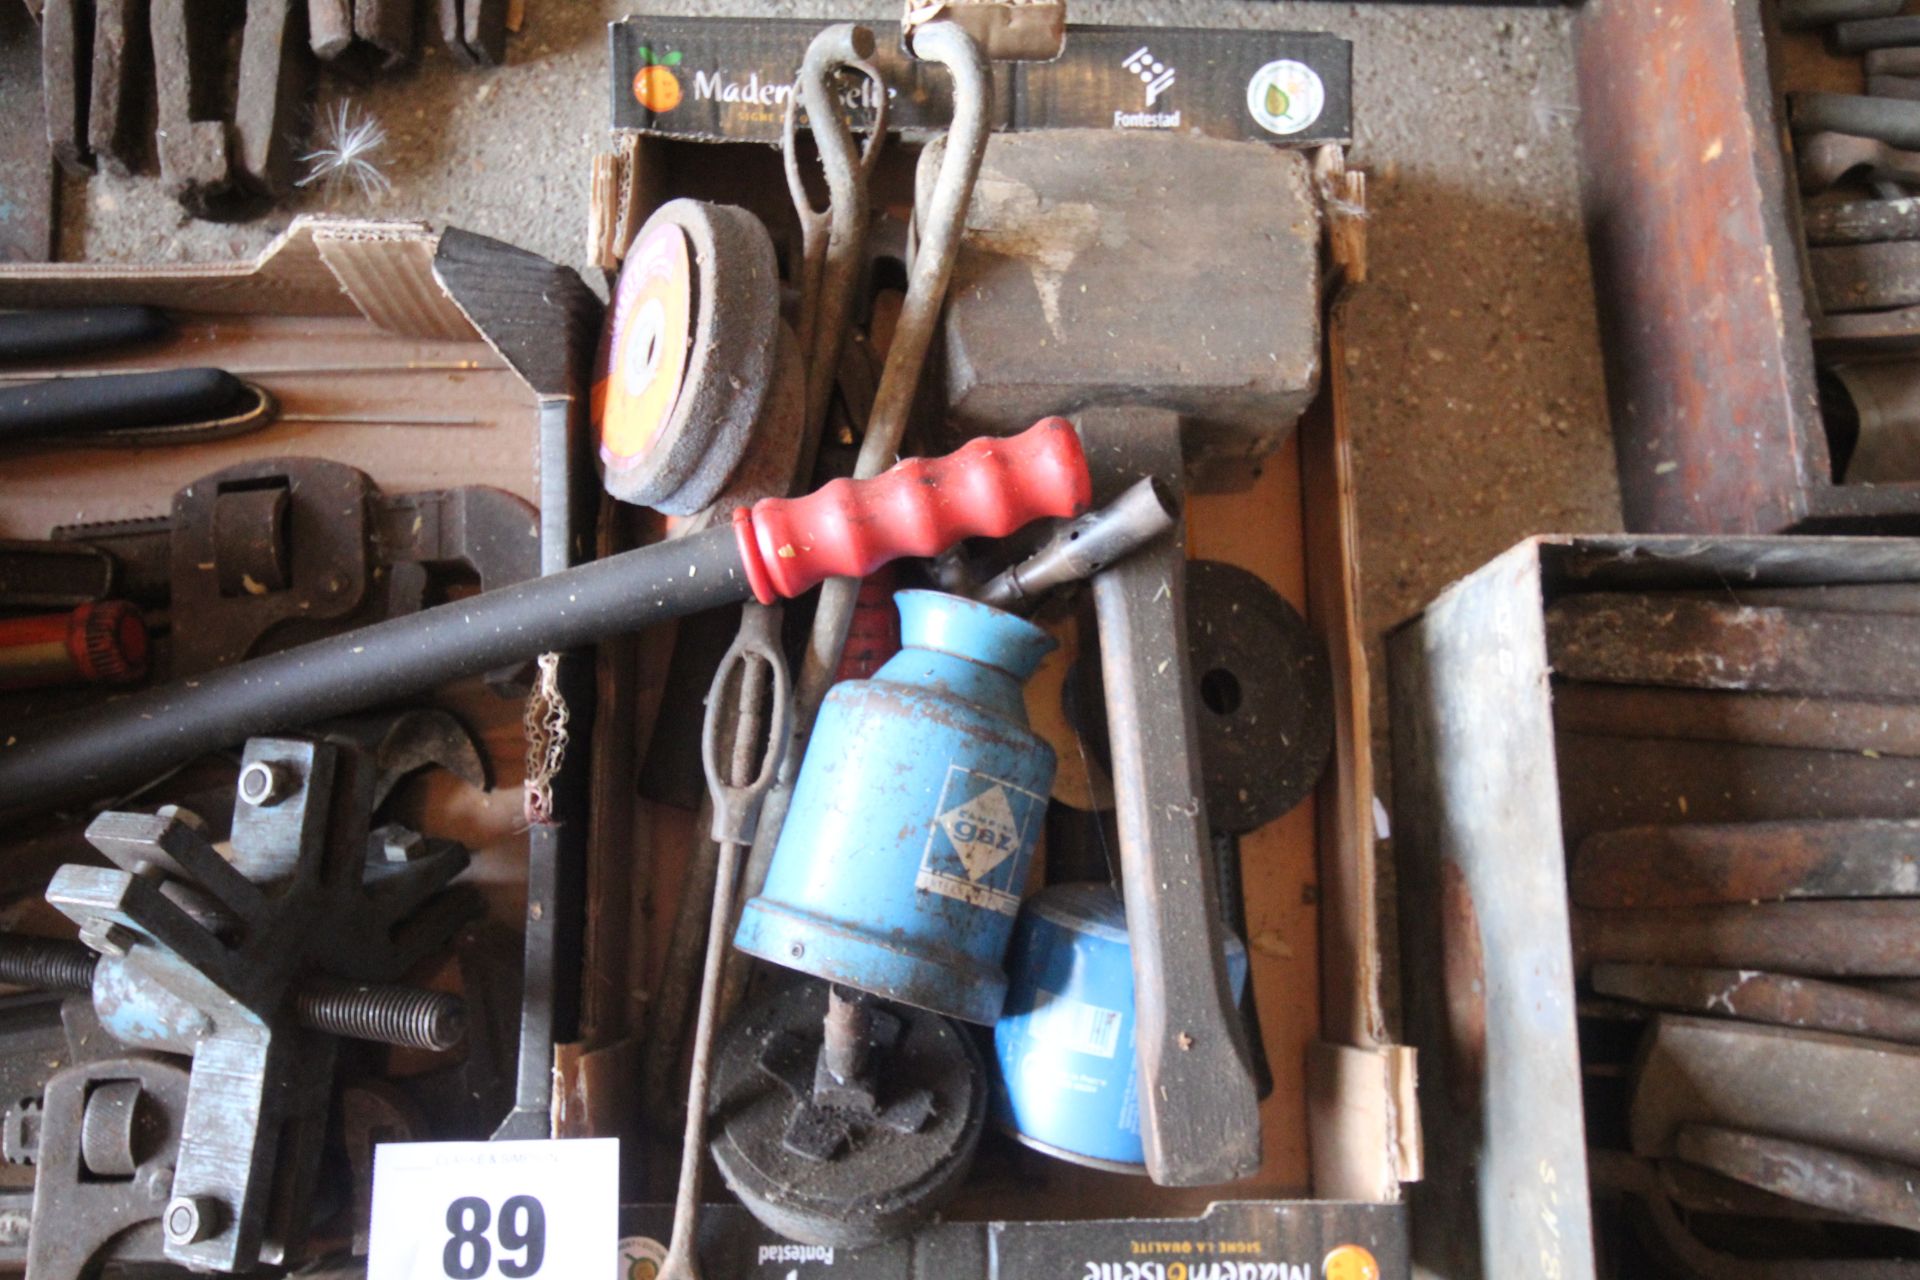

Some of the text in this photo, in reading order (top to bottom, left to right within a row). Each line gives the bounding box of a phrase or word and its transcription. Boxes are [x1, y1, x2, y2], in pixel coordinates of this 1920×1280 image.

[1113, 110, 1181, 128] Fontestad
[953, 820, 1012, 851] gaz
[442, 1194, 547, 1280] 89
[1196, 1240, 1214, 1254] LA
[1219, 1240, 1261, 1254] SIGNE
[758, 1244, 835, 1266] Fontestad
